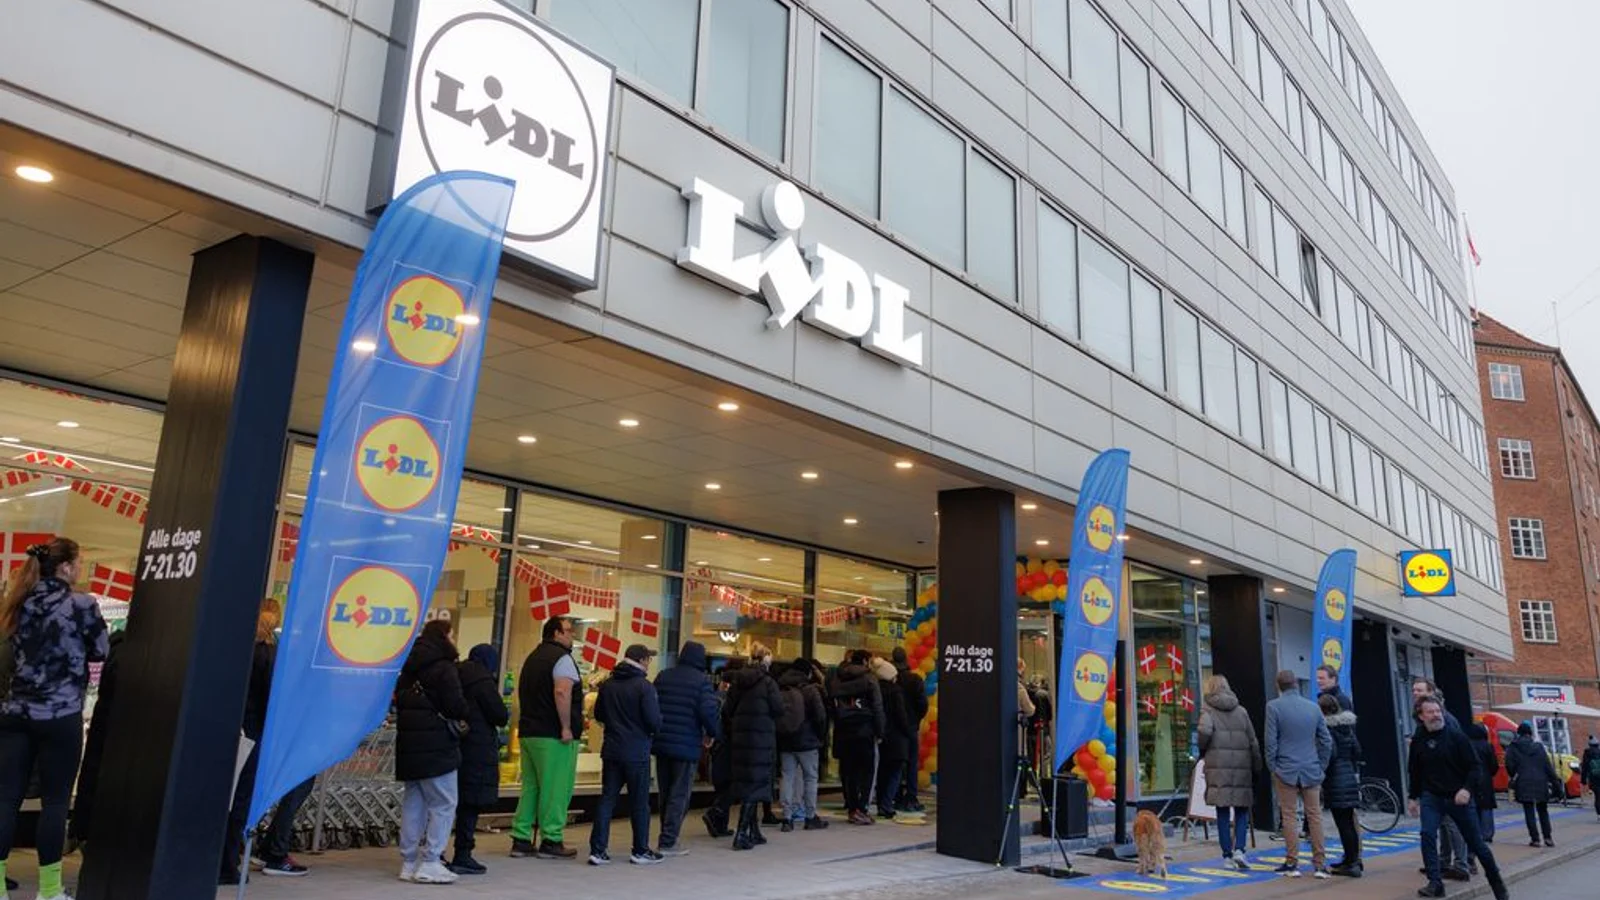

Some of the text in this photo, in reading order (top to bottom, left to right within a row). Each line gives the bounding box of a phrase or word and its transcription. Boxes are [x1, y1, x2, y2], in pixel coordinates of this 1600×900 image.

[147, 527, 202, 550] Alle dage
[141, 551, 197, 580] 7-21.30
[945, 645, 993, 658] Alle dage
[945, 658, 994, 672] 7-21.30
